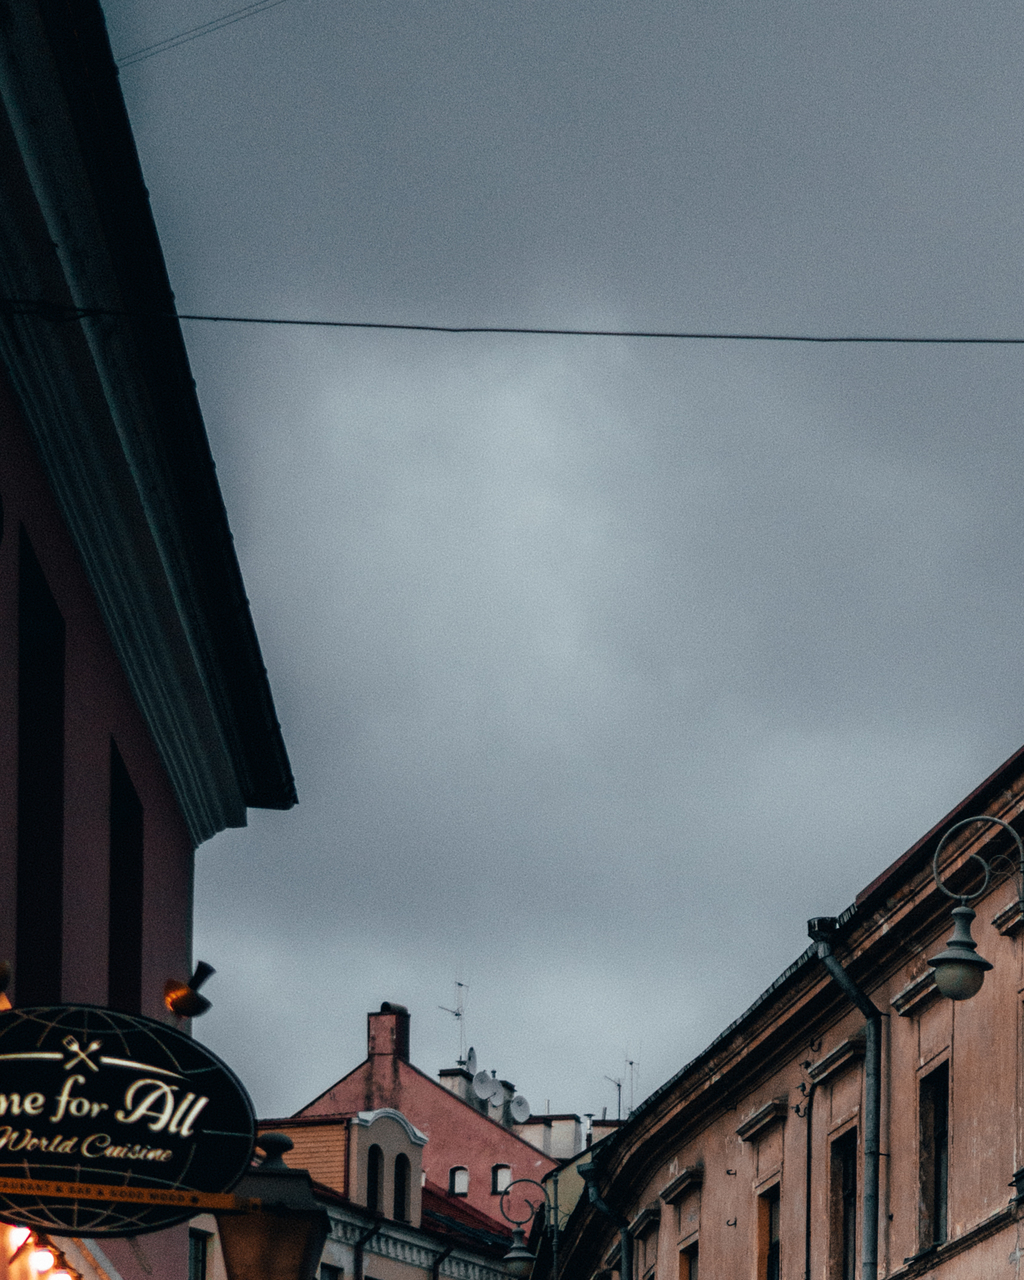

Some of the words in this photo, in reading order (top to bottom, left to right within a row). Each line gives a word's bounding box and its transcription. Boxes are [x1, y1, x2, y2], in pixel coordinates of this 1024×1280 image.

[49, 1071, 110, 1123] for
[114, 1078, 210, 1137] All
[80, 1133, 174, 1162] Cuisine
